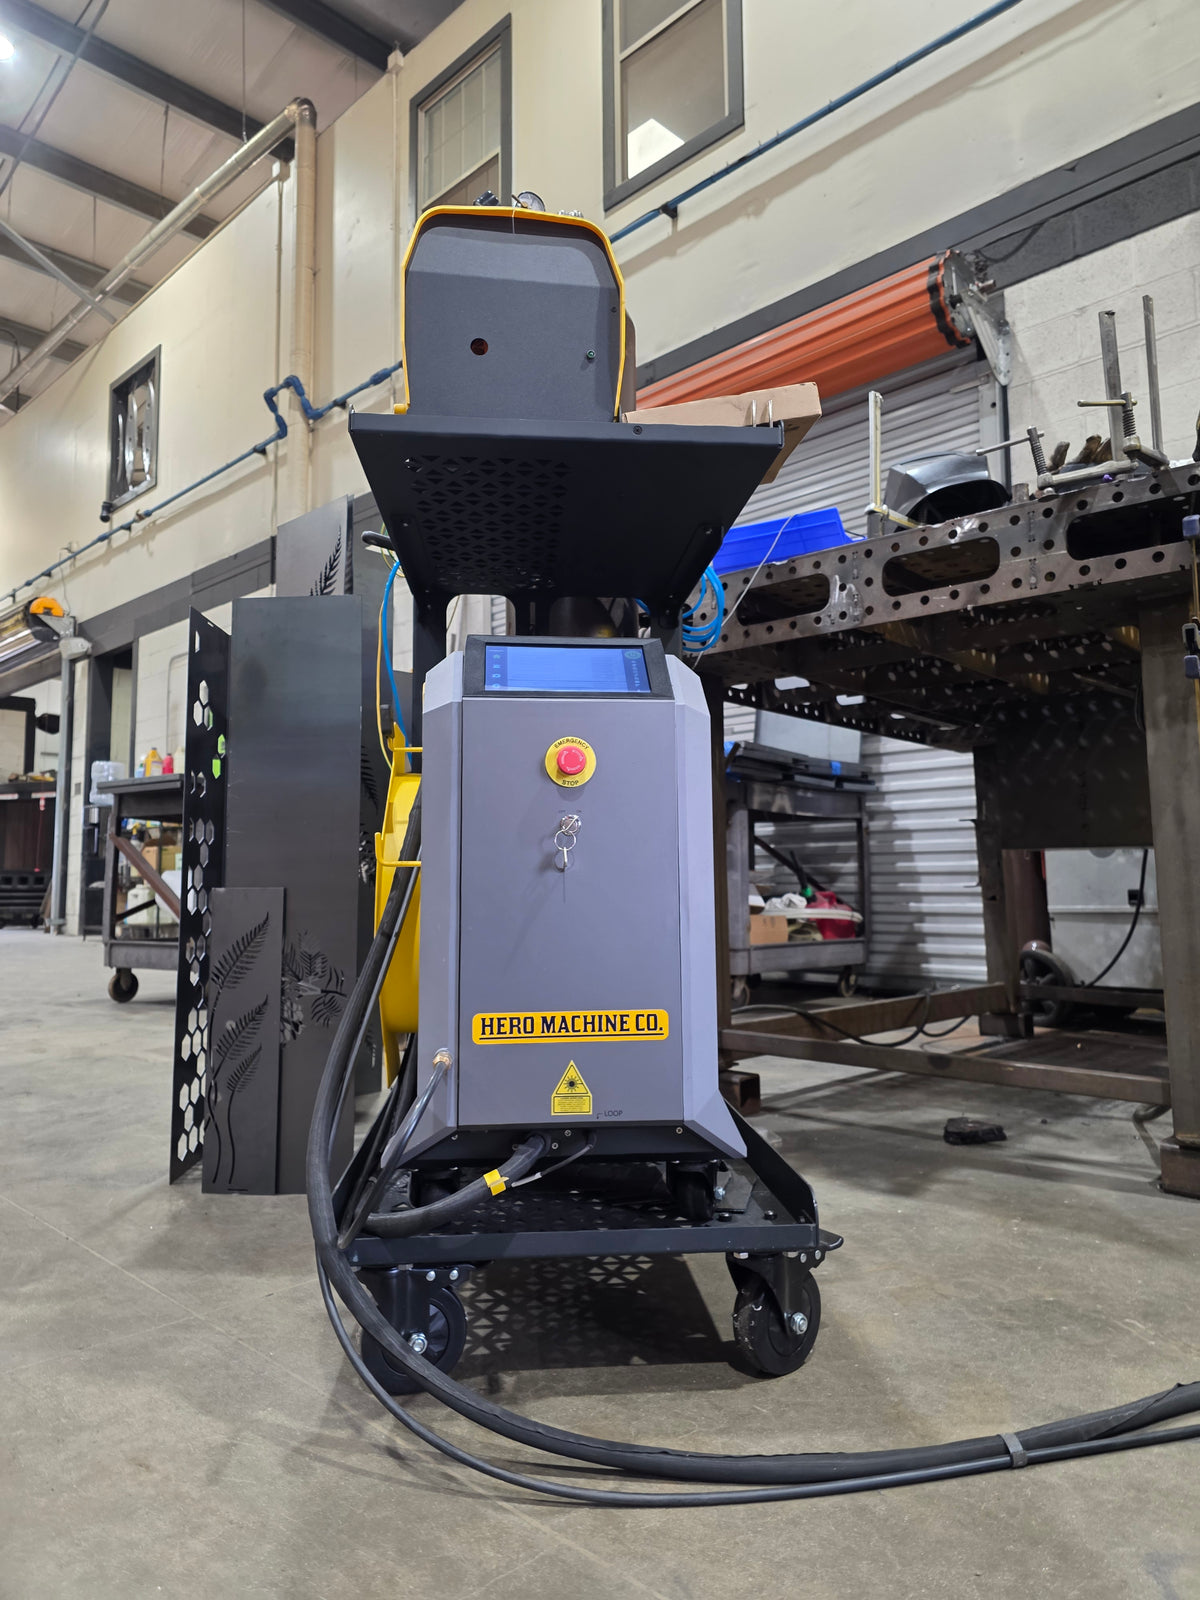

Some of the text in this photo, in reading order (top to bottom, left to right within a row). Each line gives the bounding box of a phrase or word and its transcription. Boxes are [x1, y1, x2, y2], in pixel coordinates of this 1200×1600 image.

[554, 738, 589, 749] EMERGENCY
[481, 1013, 663, 1035] HERO MACHINE CO.
